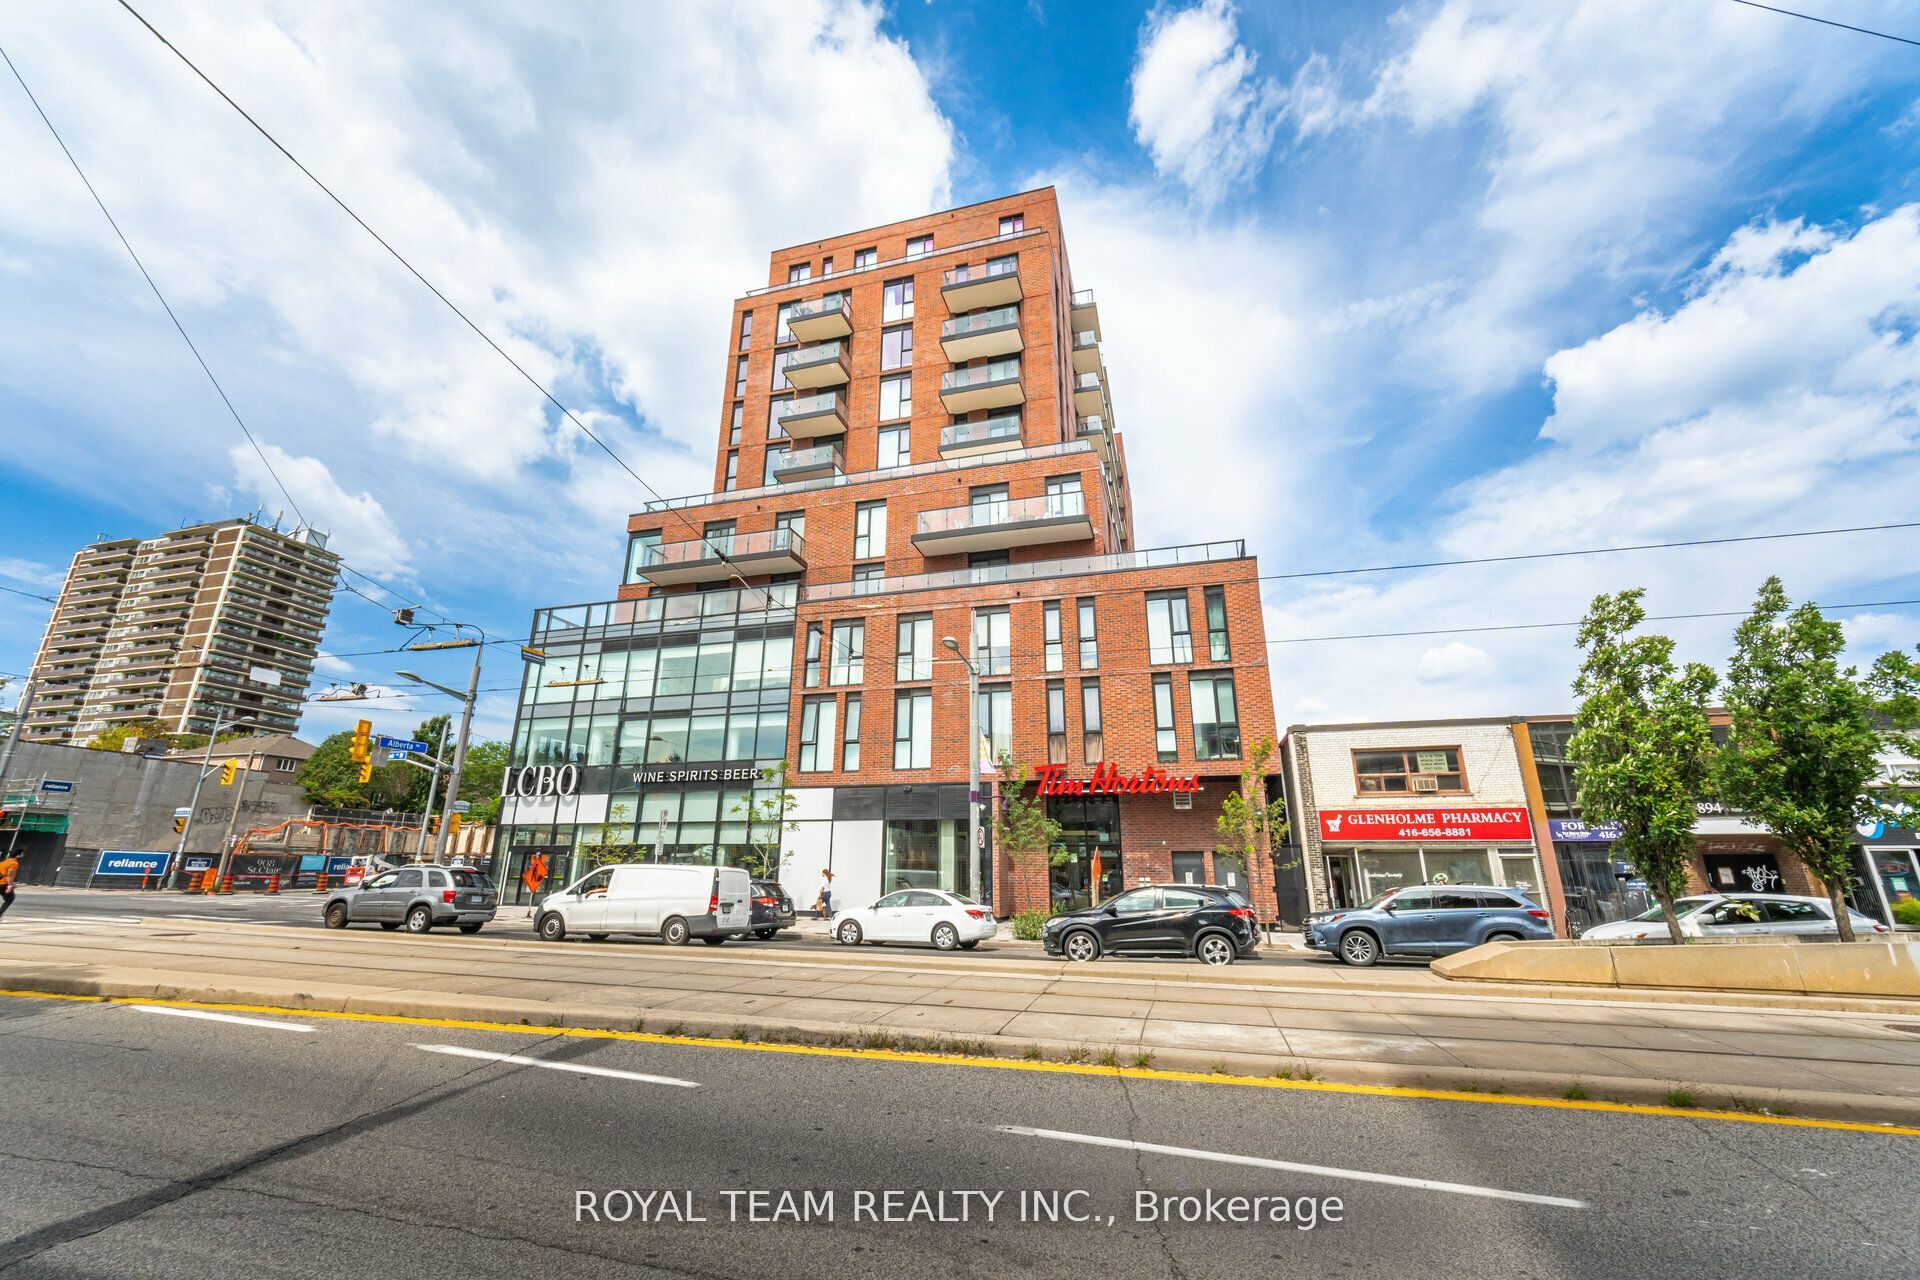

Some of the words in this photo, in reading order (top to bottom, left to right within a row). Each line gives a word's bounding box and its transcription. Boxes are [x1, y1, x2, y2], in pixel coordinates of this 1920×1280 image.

[388, 740, 414, 750] Alberta
[500, 764, 577, 797] LCBO
[633, 772, 664, 783] WINE
[669, 770, 718, 782] SPIRITS
[723, 768, 759, 780] BEER
[1034, 763, 1083, 797] Tim
[1088, 761, 1200, 795] Hortons
[1697, 802, 1722, 814] 894
[1348, 813, 1435, 825] GLENHOLME
[1442, 812, 1522, 824] PHARMACY
[1560, 821, 1585, 831] FOR
[1398, 828, 1472, 837] 416-656-8881
[108, 859, 158, 868] reliance
[256, 859, 276, 867] 908
